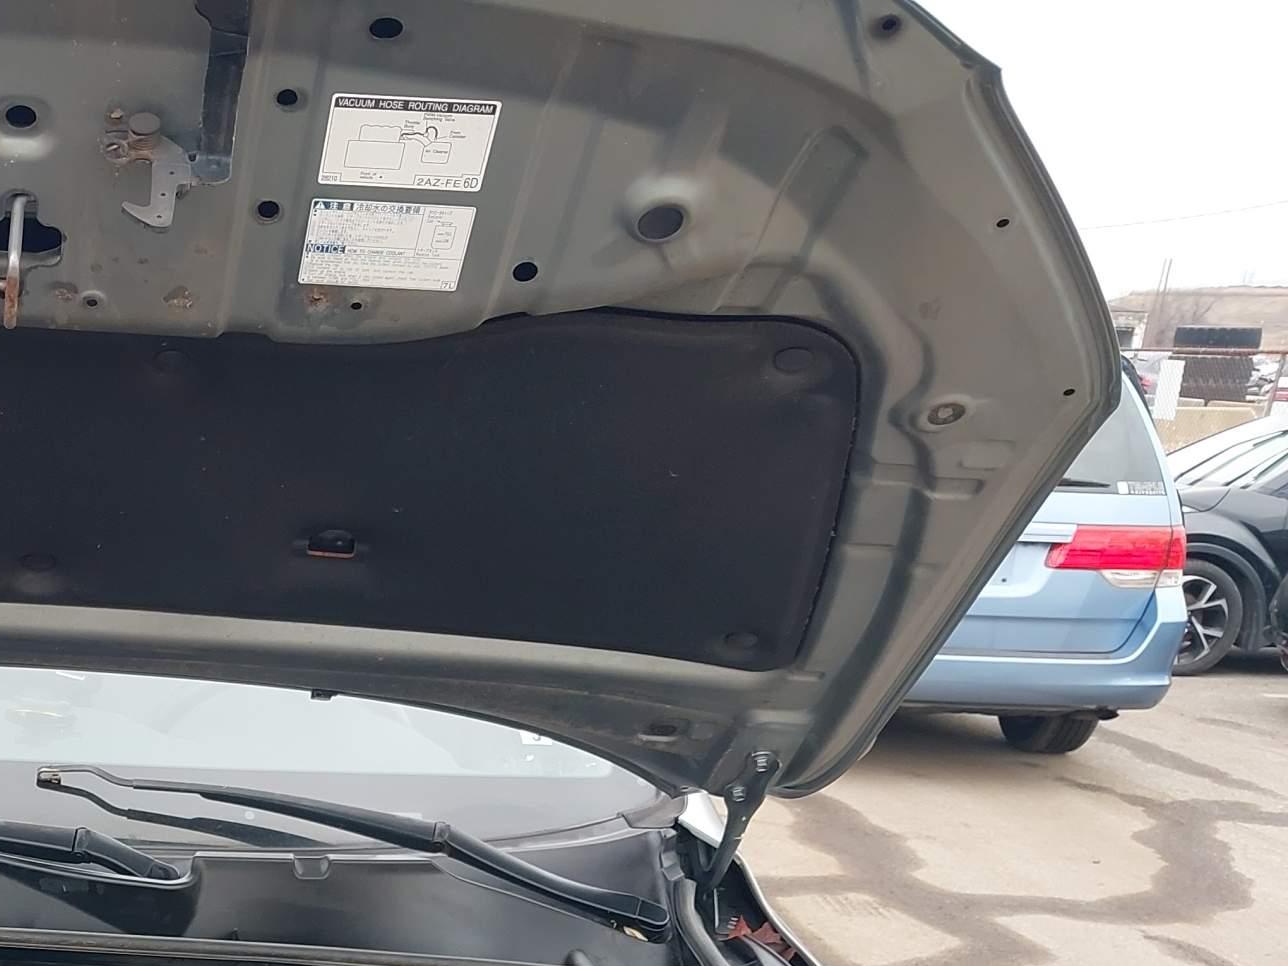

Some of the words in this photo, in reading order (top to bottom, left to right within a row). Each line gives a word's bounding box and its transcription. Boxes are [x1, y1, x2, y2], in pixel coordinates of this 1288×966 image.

[337, 97, 375, 107] VACUUM
[378, 99, 404, 108] HOSE
[407, 100, 449, 111] ROUTING
[451, 103, 493, 113] DIAGRAM
[416, 177, 461, 187] 2AZ-FE
[463, 177, 478, 188] 6D
[306, 243, 344, 252] NOTICE
